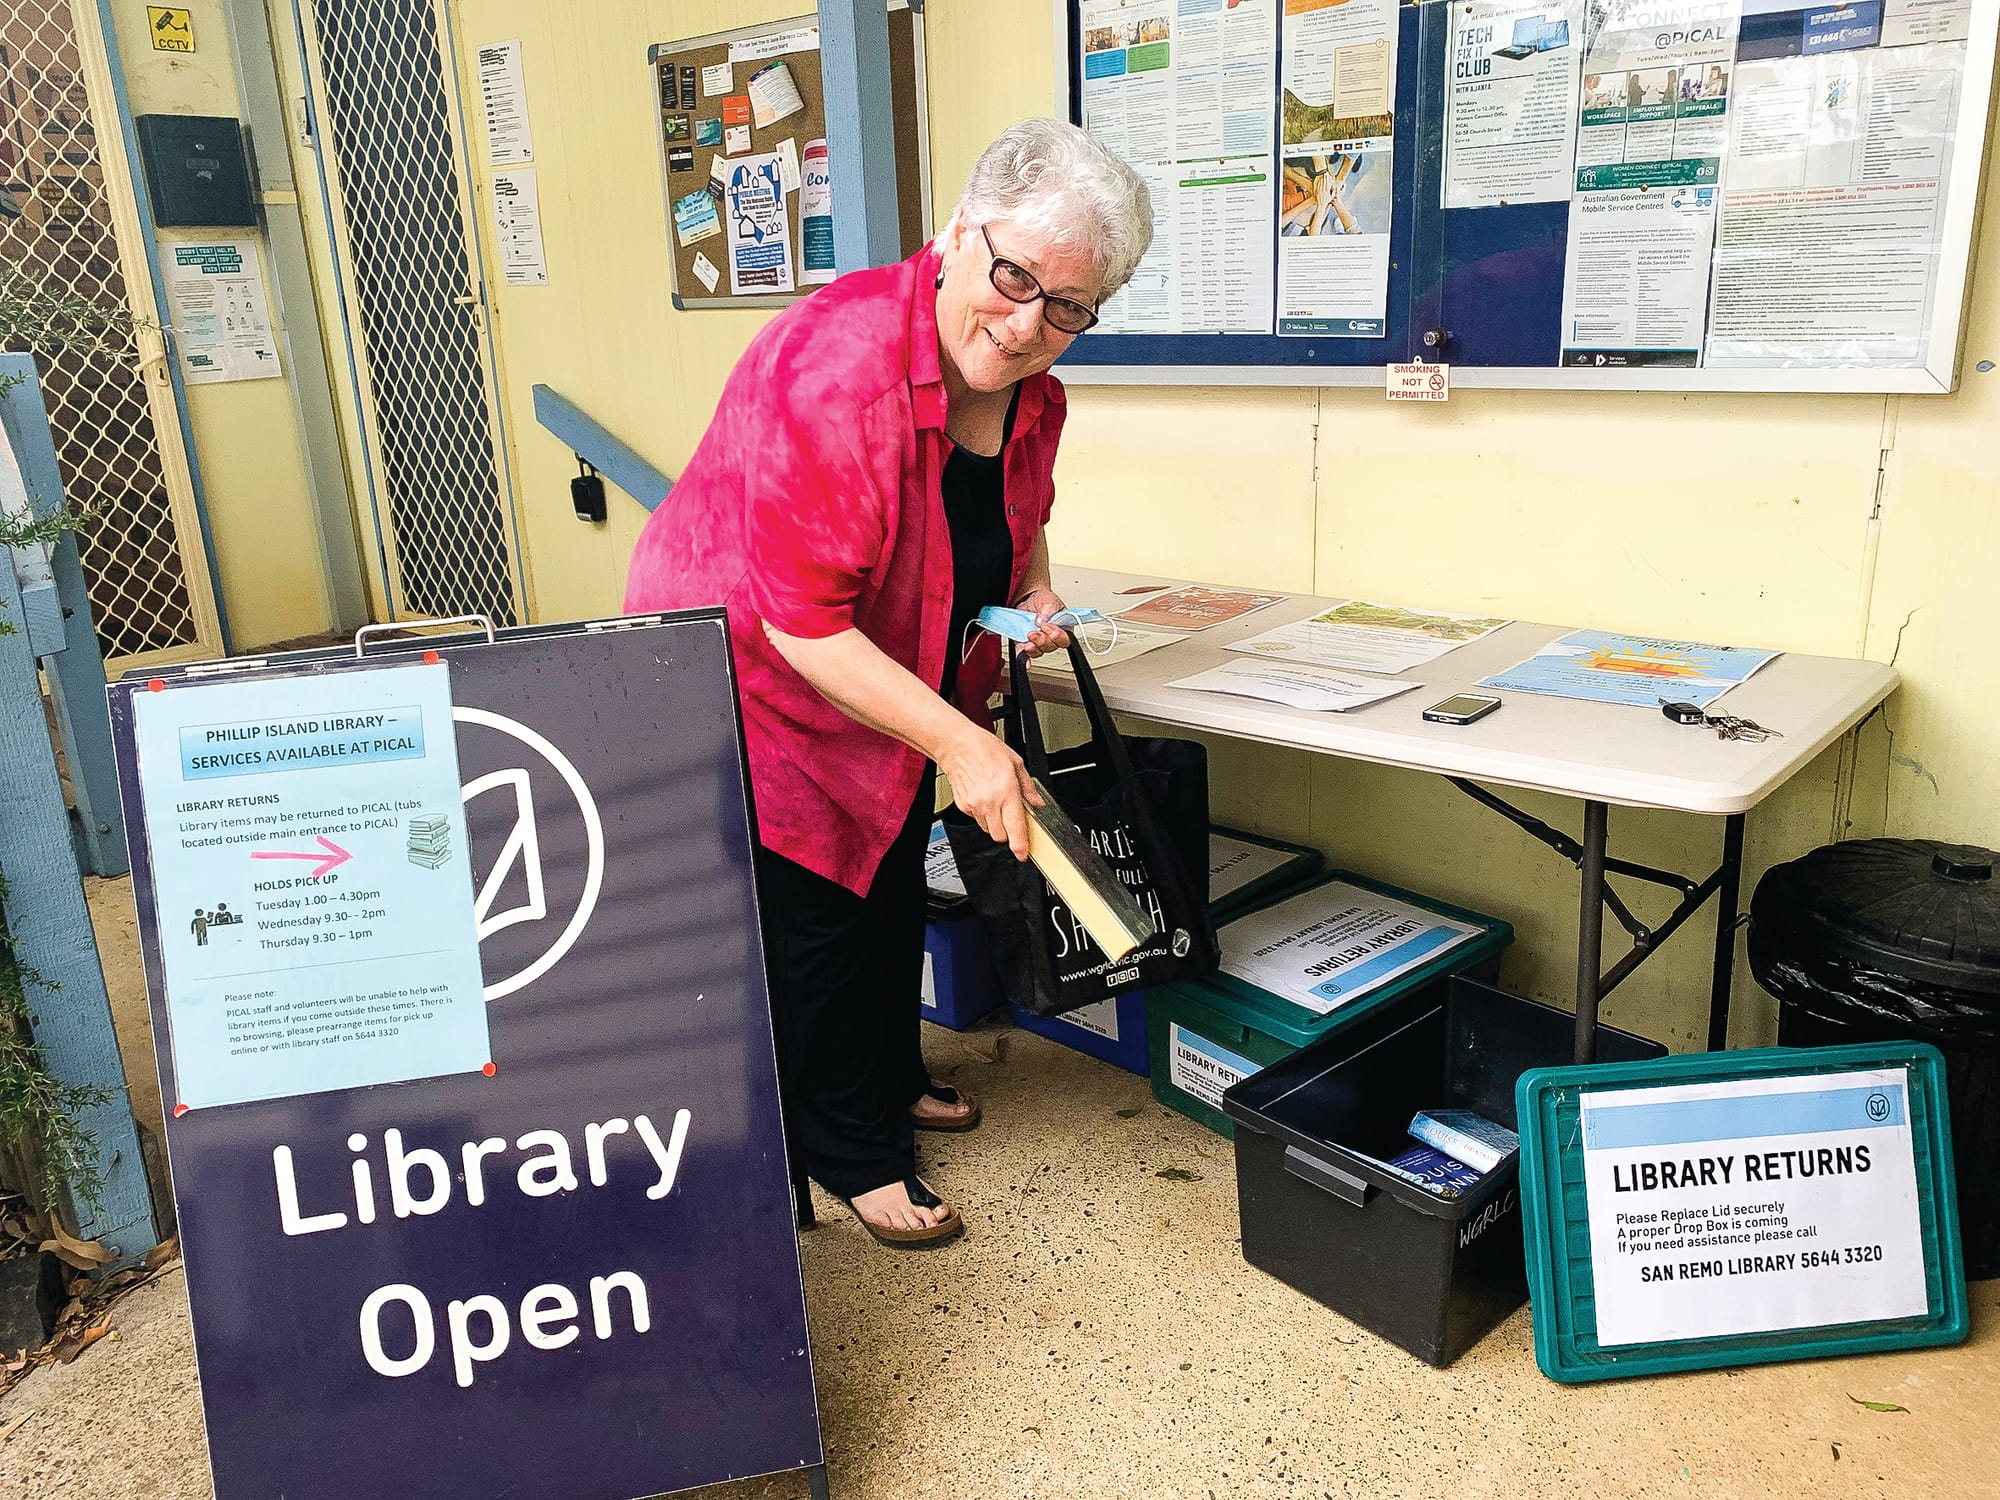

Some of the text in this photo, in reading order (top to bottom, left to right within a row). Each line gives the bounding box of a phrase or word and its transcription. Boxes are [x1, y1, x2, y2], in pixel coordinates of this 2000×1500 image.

[158, 38, 189, 50] CCTV
[1458, 26, 1493, 47] TECH
[1655, 26, 1726, 50] @PICAL
[1457, 46, 1483, 60] FIX IT
[1456, 58, 1491, 78] CLUB
[1456, 86, 1469, 94] WITH
[1586, 112, 1622, 120] WORKSPACE
[1633, 105, 1671, 113] EMPLOYMENT
[1582, 202, 1665, 213] Mobile Service Centres
[1583, 191, 1666, 204] Australian Government
[1394, 365, 1440, 374] SMOKING
[1402, 378, 1423, 387] NOT
[1389, 390, 1445, 400] PERMITTED
[207, 715, 384, 744] PHILLIP ISLAND LIBRARY
[192, 736, 416, 770] SERVICES AVAILABLE AT PICAL
[177, 794, 281, 813] LIBRARY RETURNS
[180, 799, 422, 834] Library items may be returned to PICAL (tubs
[182, 817, 398, 849] located outside main entrance to PICAL)
[254, 872, 339, 892] HOLDS PICK UP
[256, 891, 381, 912] Tuesday 1.00 4.30pm
[257, 915, 322, 931] Wednesday
[361, 907, 387, 922] 2pm
[260, 929, 374, 950] Thursday 9.30 1pm
[1368, 919, 1424, 953] LIBRARY
[1303, 942, 1372, 977] RETURNS
[225, 990, 277, 1003] Please note:
[227, 983, 449, 1018] PICAL staff and volunteers will be unable to help with
[228, 996, 453, 1032] library items if you come outside these times. There is
[243, 1030, 285, 1042] browsing,
[287, 1026, 315, 1038] please
[316, 1022, 363, 1034] prearrange
[365, 1018, 388, 1027] items
[390, 1015, 402, 1024] for
[404, 1012, 421, 1023] pick
[423, 1011, 434, 1021] up
[231, 1027, 400, 1056] online or with library staff on 5644 3320
[1177, 1046, 1216, 1074] LIBRARY
[272, 1108, 692, 1238] Library
[1614, 1145, 1872, 1193] LIBRARY RETURNS
[1460, 1189, 1515, 1249] WGRLC
[1616, 1201, 1785, 1225] Please Replace Lid securely
[1617, 1216, 1789, 1241] A proper Drop Box is coming
[1618, 1225, 1818, 1255] If you need assistance please call
[1642, 1245, 1883, 1283] SAN REMO LIBRARY 5644 3320
[358, 1268, 651, 1388] Open
